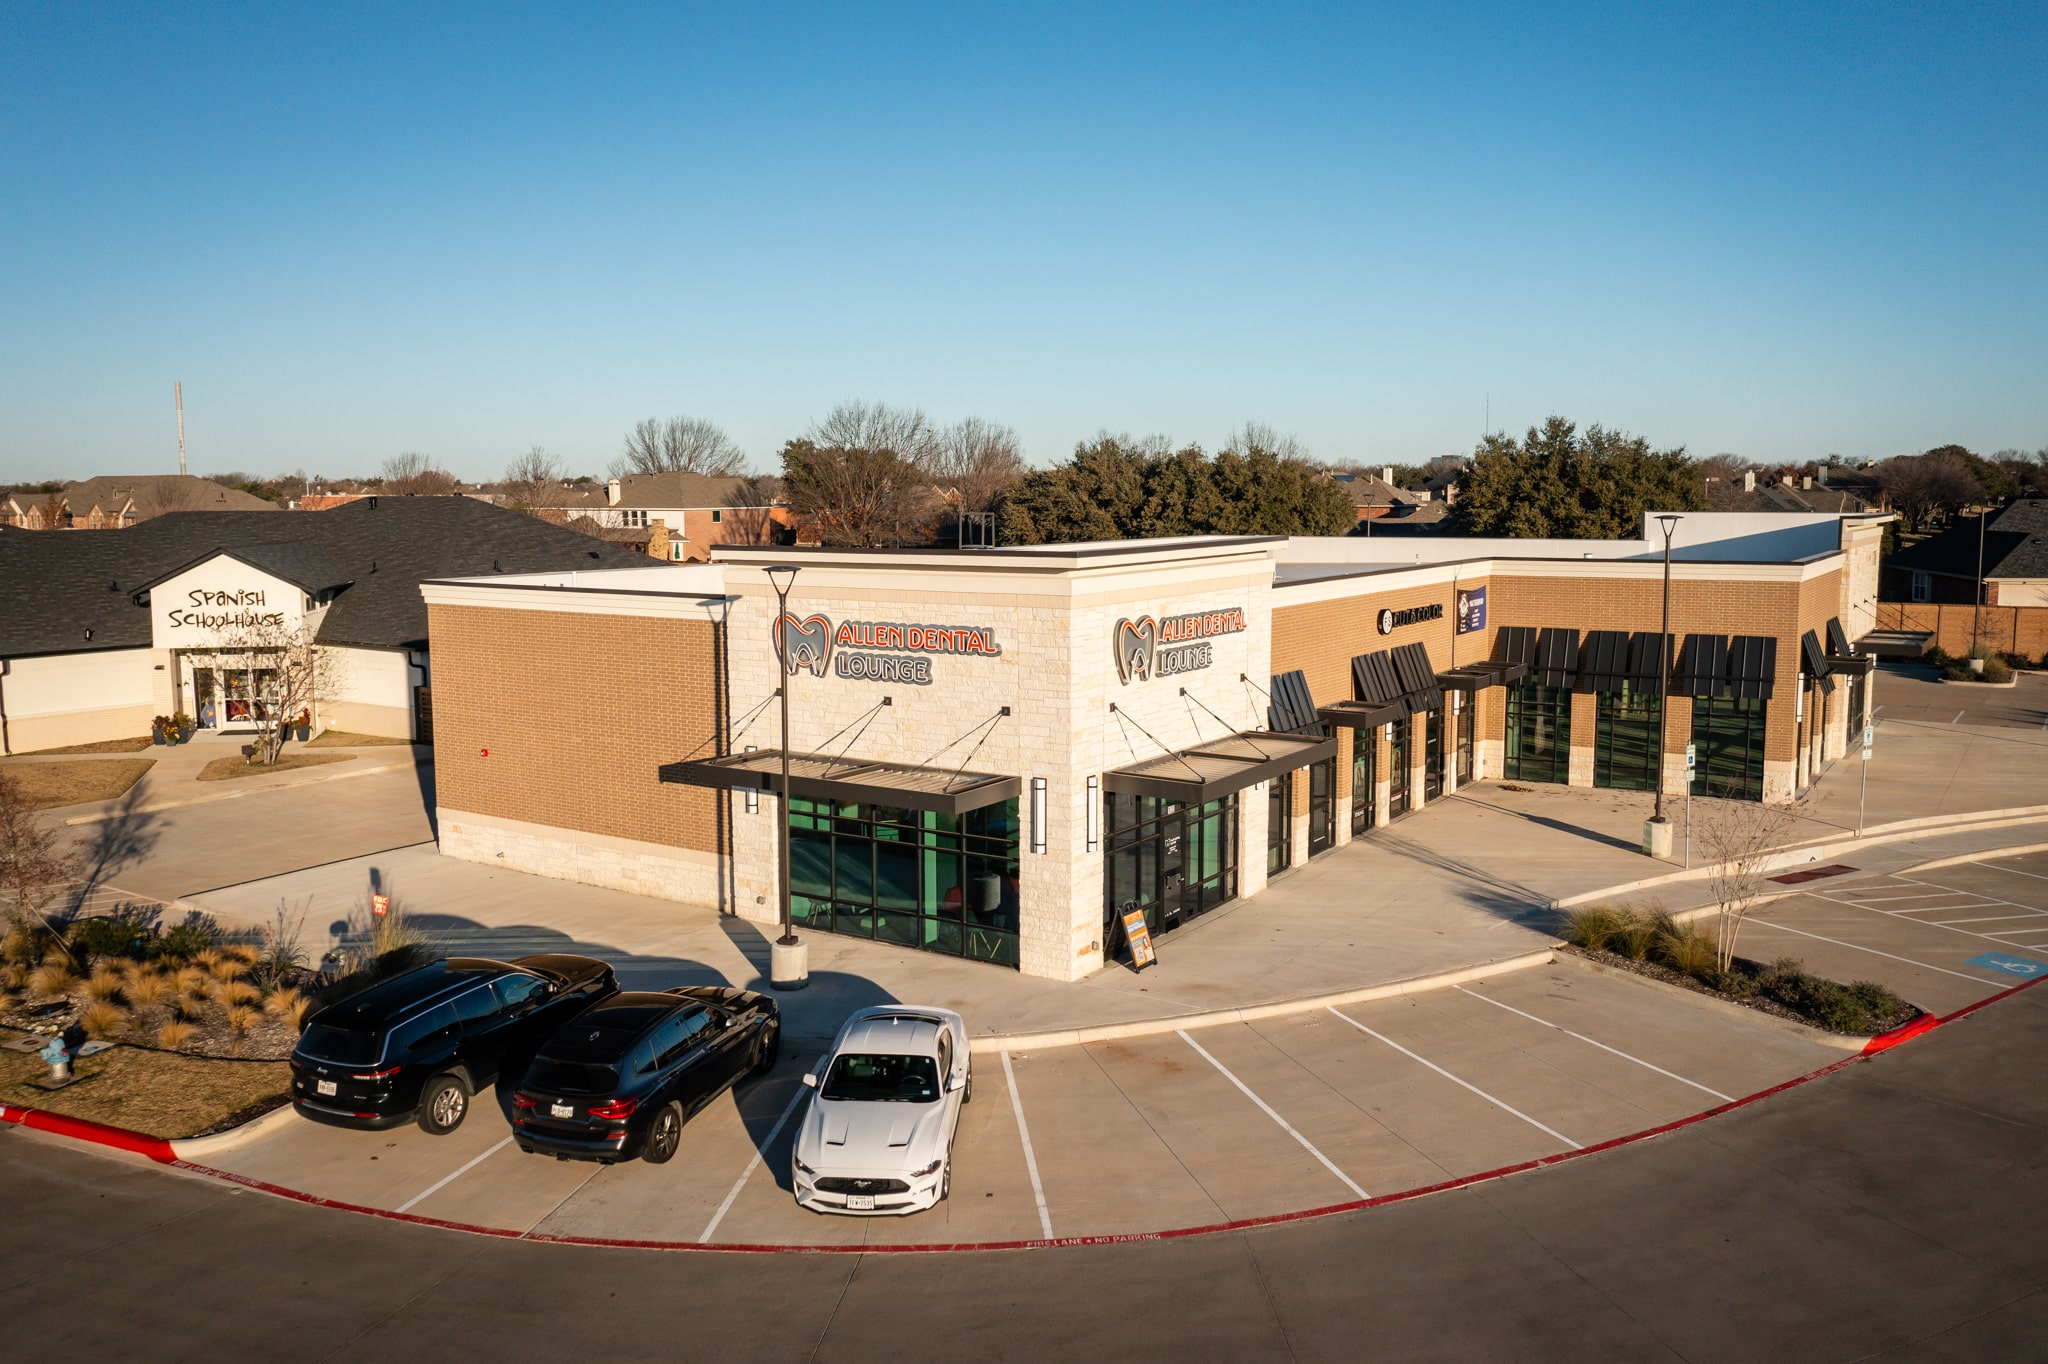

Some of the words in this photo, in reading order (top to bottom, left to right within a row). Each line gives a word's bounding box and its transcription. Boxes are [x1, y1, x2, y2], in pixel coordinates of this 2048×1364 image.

[168, 609, 285, 629] SCHOOLHOUSE
[1163, 617, 1202, 642] ALLEN
[1203, 610, 1247, 635] DENTAL
[837, 622, 903, 647] ALLEN
[908, 628, 997, 653] DENTAL
[837, 654, 929, 682] LOUNGE
[1161, 646, 1214, 673] LOUNGE
[1054, 1238, 1083, 1246] LANE
[1094, 1236, 1110, 1244] NO
[1113, 1233, 1161, 1243] PARKING
